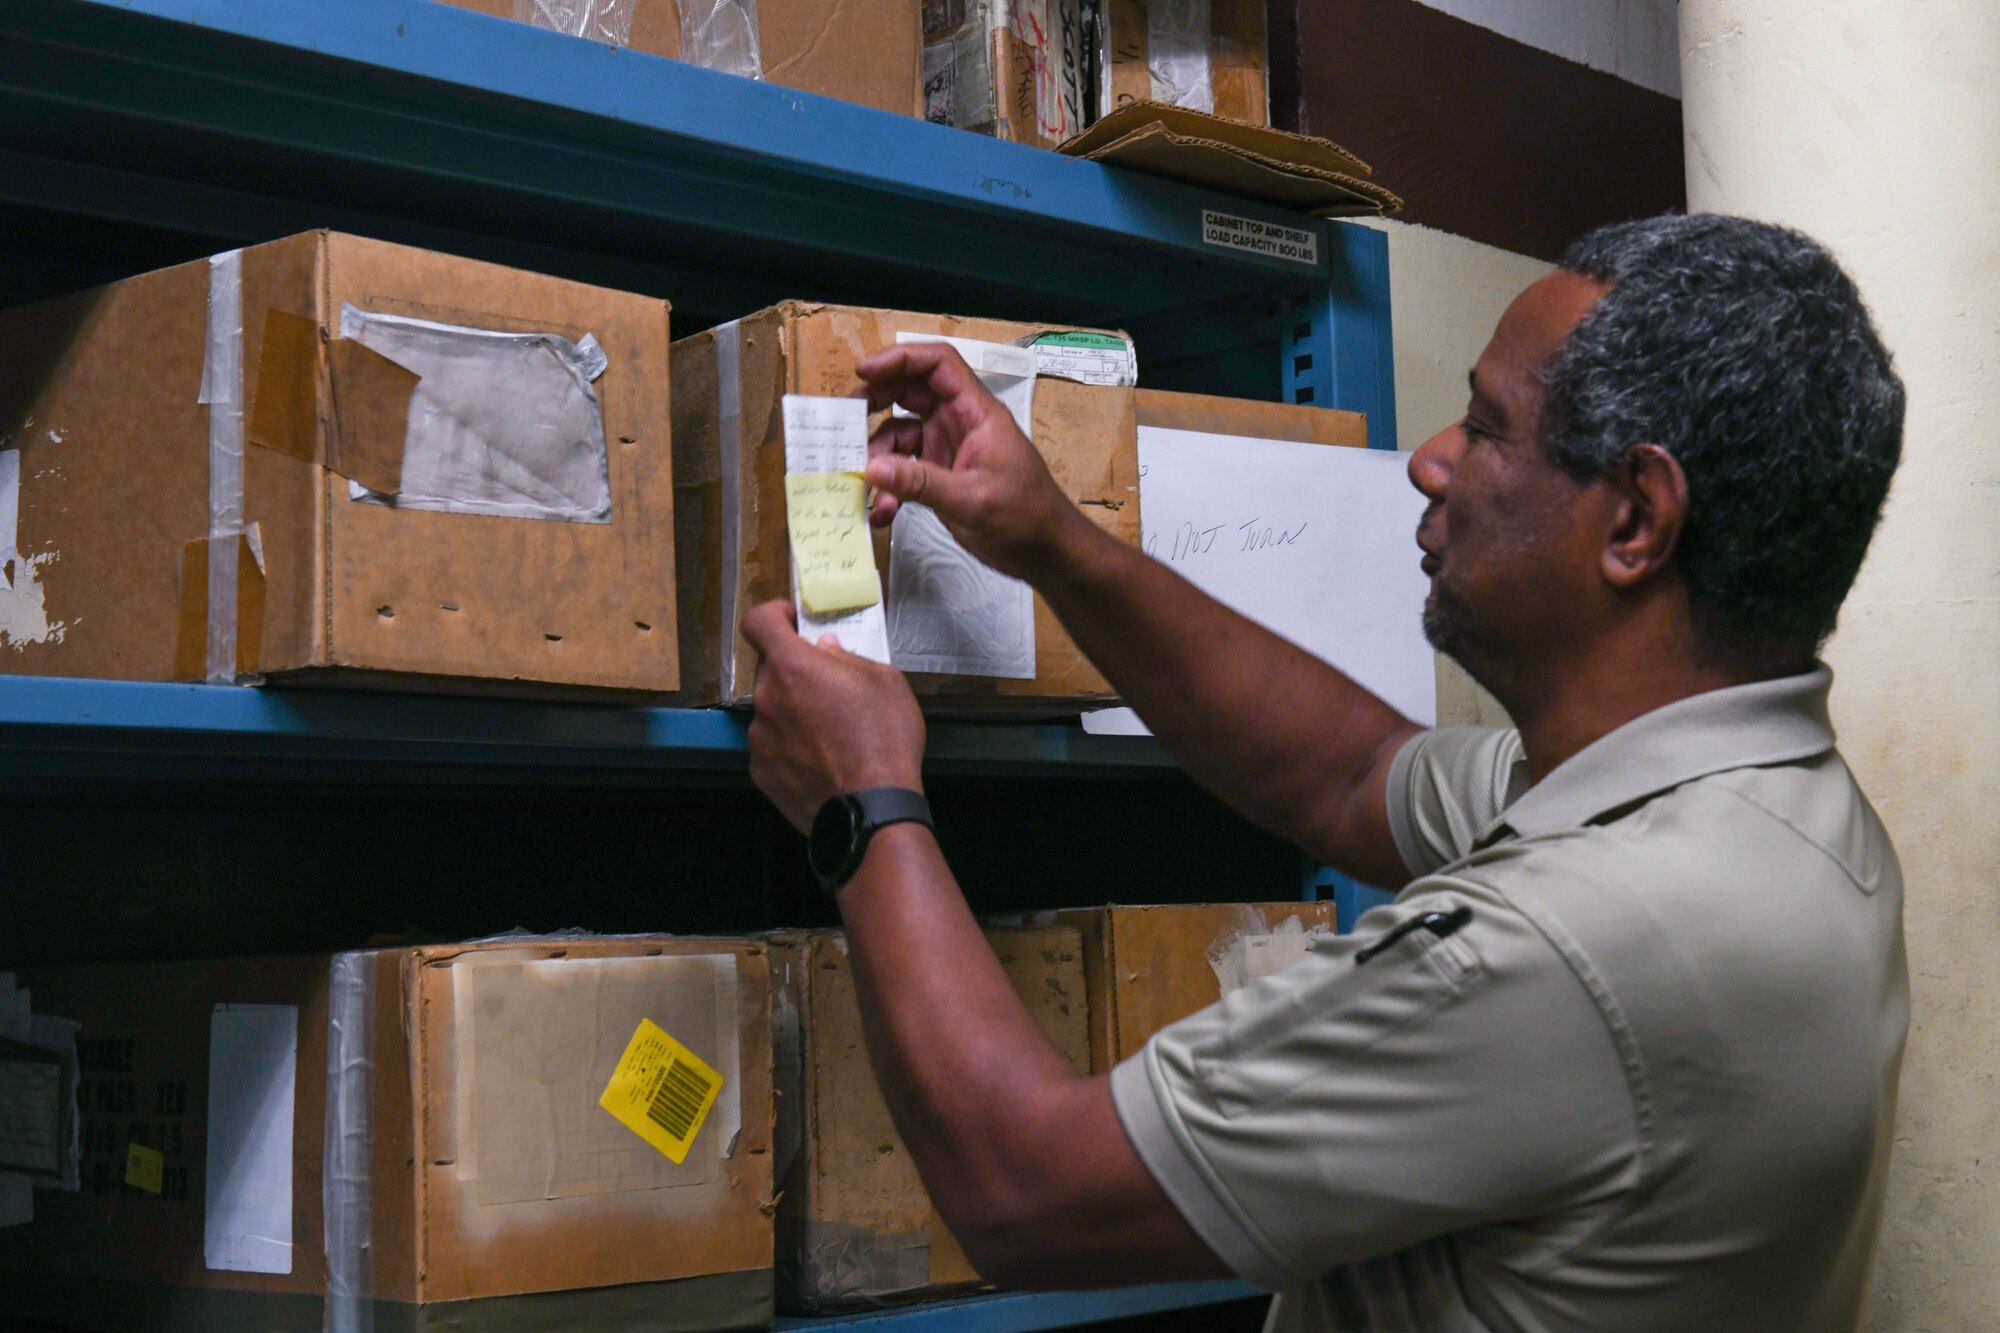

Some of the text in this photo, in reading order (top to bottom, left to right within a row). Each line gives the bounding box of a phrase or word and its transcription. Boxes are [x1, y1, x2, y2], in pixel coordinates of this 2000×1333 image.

[1205, 213, 1309, 243] CABINET TOP AND SHELF
[1206, 229, 1231, 243] LOAD
[1232, 234, 1277, 253] CAPACITY
[1298, 248, 1314, 260] LBS
[1171, 520, 1226, 561] NOT
